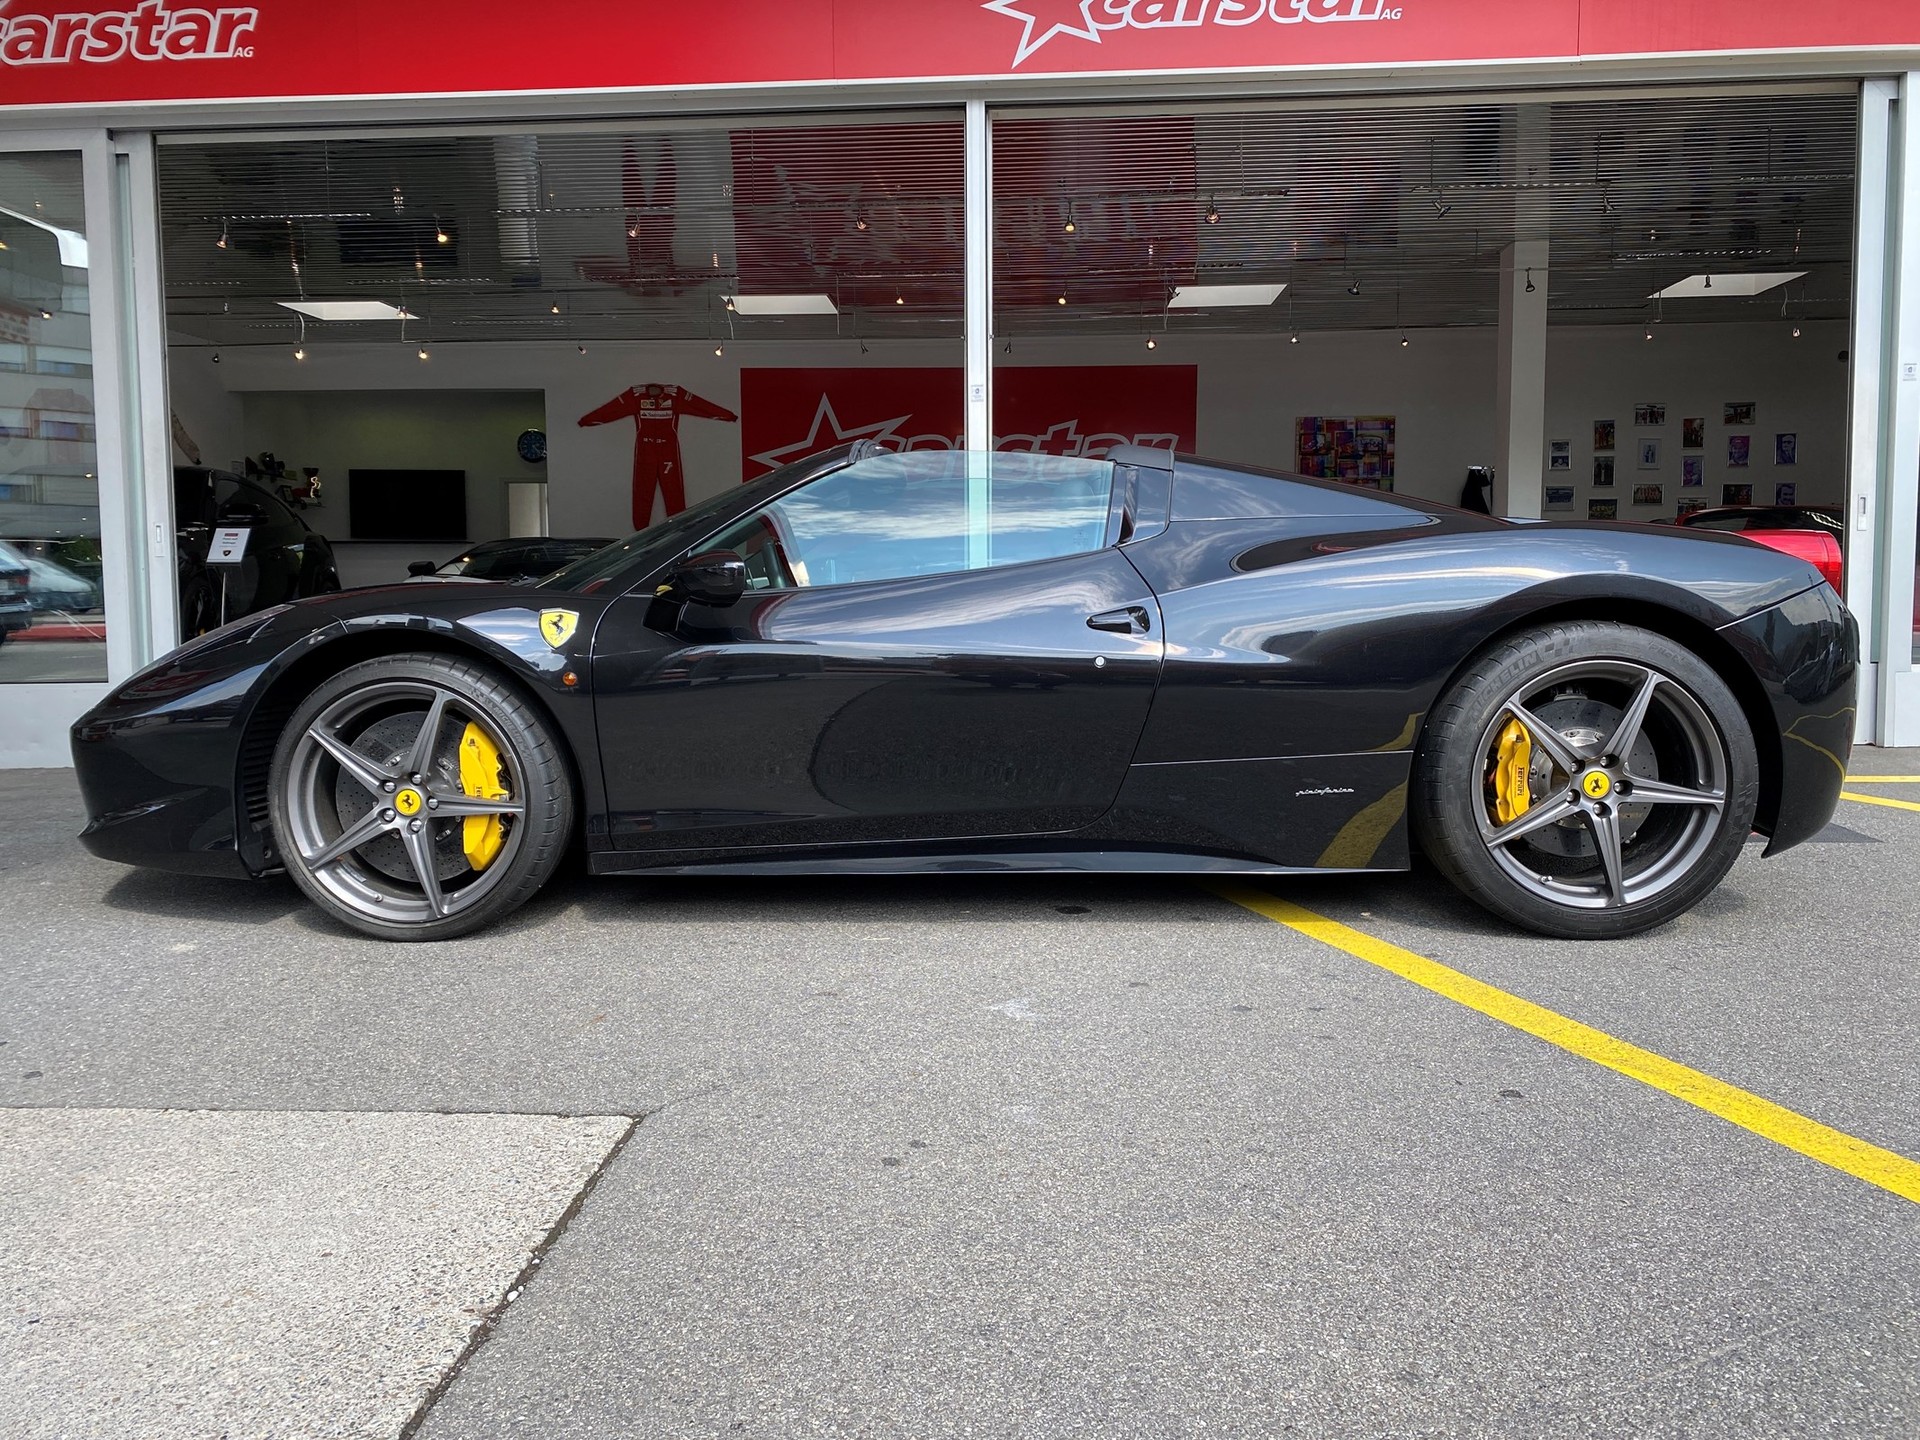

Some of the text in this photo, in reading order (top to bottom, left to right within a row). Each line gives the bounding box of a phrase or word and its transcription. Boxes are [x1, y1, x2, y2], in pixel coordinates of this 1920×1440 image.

[0, 0, 258, 65] arstar AG
[1380, 7, 1402, 20] AG
[663, 461, 673, 474] 7
[1465, 650, 1540, 720] MICHELIN
